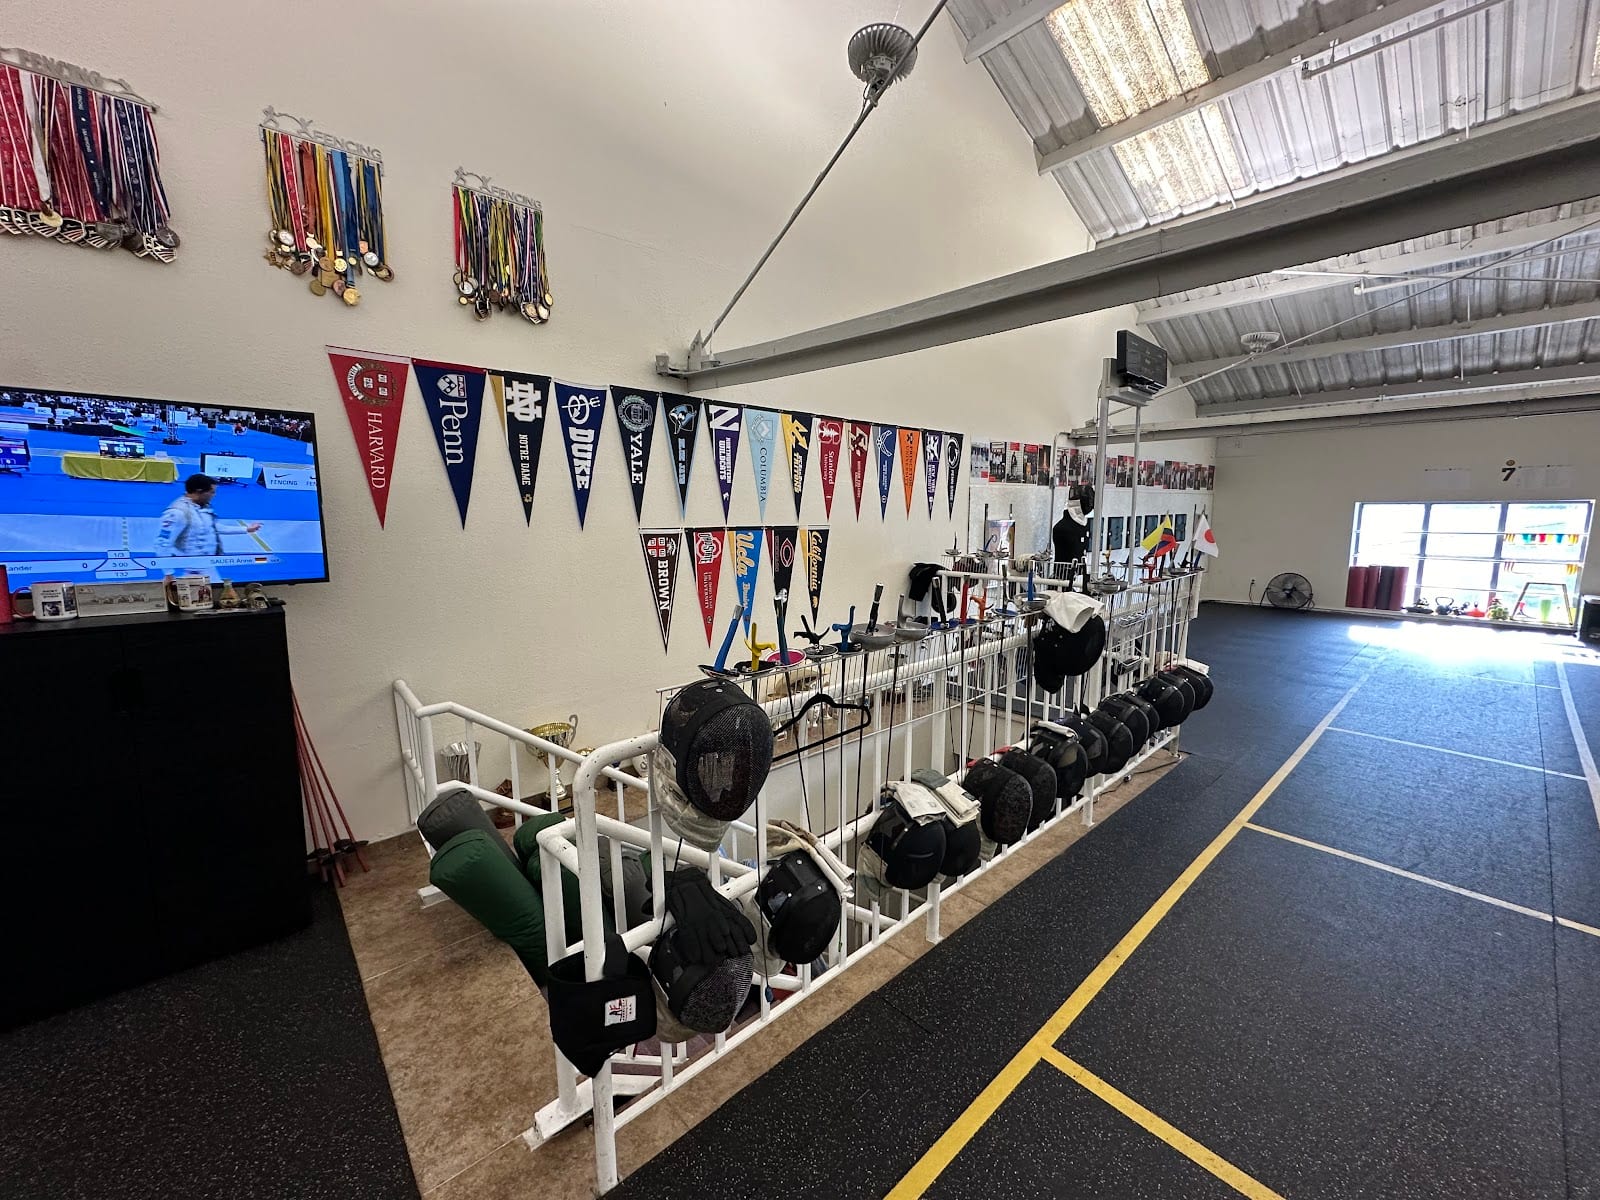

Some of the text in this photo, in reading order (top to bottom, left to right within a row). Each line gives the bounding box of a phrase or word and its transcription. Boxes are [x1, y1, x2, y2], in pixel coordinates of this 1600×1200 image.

[313, 130, 382, 160] FENCING
[491, 186, 543, 210] FENCING
[367, 411, 386, 490] HARVARD
[439, 398, 469, 466] Penn
[568, 426, 595, 490] DUKE
[630, 432, 643, 485] YALE
[518, 433, 531, 486] NOTRE DAME
[718, 440, 727, 480] WILDCATS
[760, 447, 768, 502] COLUMBIA
[793, 452, 801, 494] TRITONS
[1501, 467, 1516, 482] 7
[658, 559, 670, 610] BROWN
[808, 531, 823, 592] California
